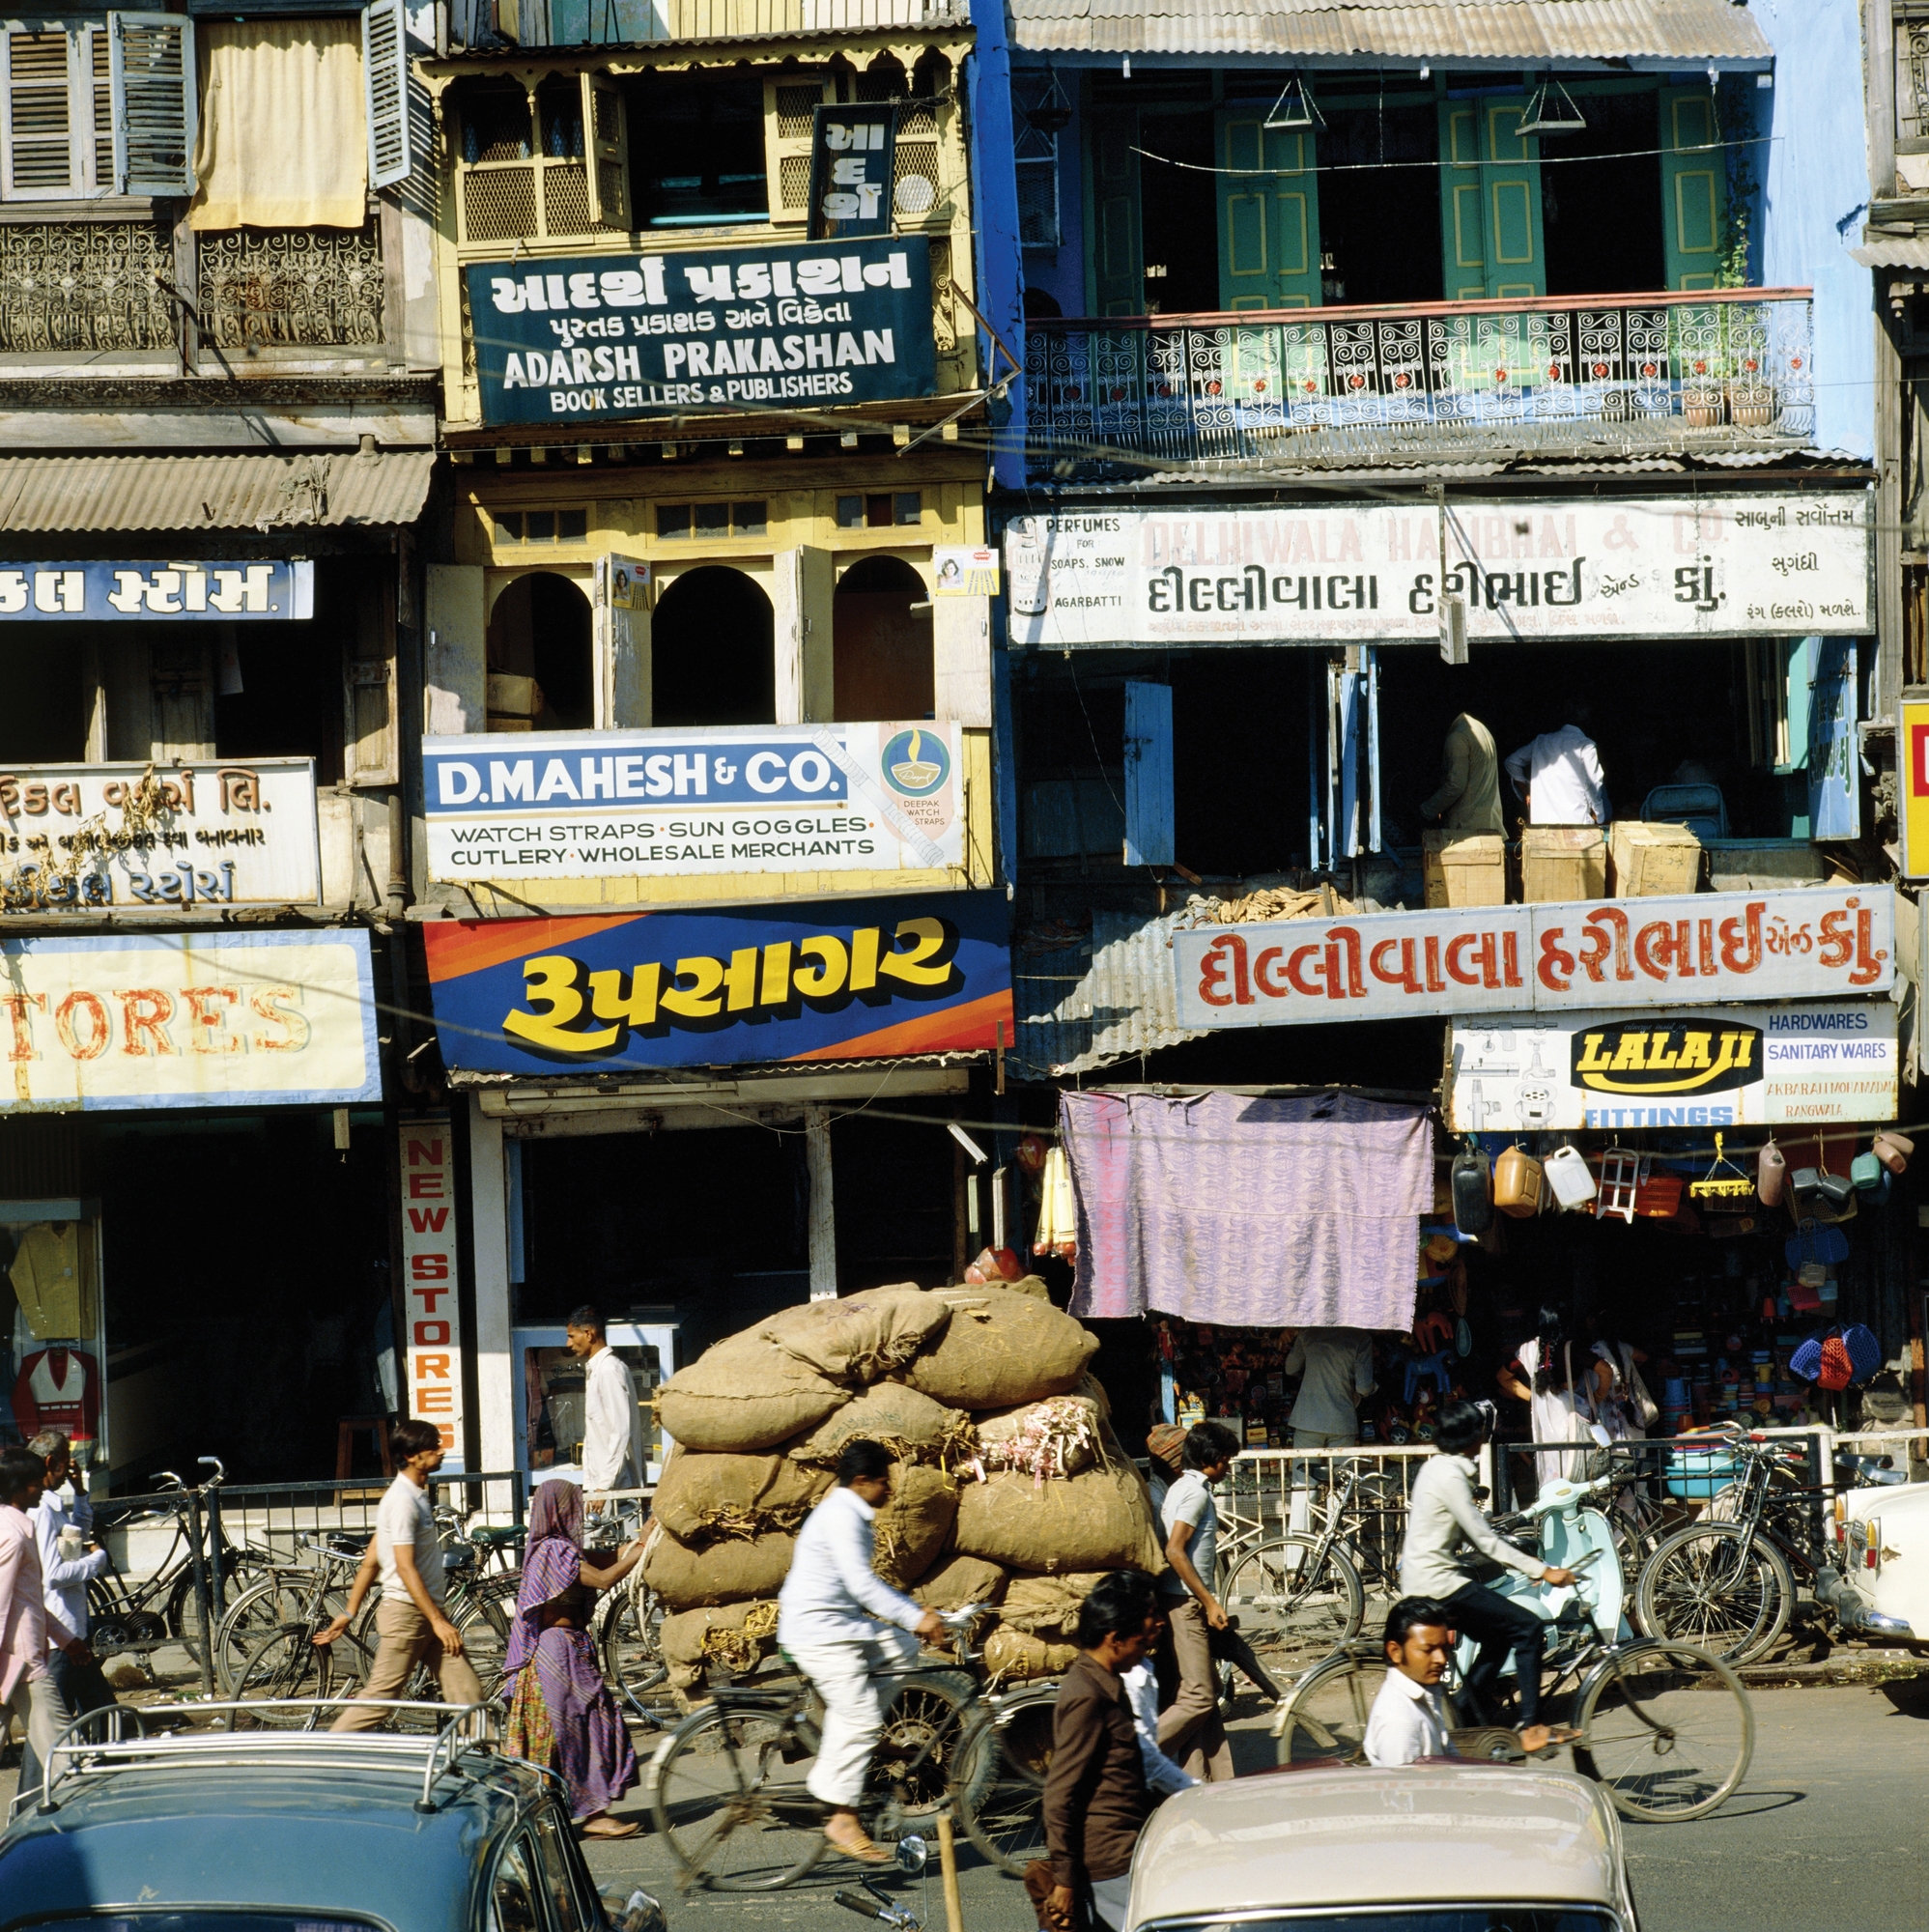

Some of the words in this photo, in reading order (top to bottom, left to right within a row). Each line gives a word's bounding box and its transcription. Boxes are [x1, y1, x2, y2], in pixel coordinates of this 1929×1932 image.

[491, 255, 667, 312] આદર્શ
[684, 252, 912, 302] પ્રકાશન
[631, 311, 717, 337] પ્રકાશક
[724, 300, 774, 331] અને
[503, 346, 641, 389] ADARSH
[663, 328, 894, 379] PRAKASHAN
[550, 388, 609, 412] BOOK
[612, 383, 705, 409] SELLERS
[709, 385, 725, 404] &
[725, 371, 854, 402] PUBLISHERS
[1045, 518, 1121, 533] PERFUMES
[1140, 518, 1364, 566] DELHIWALA
[1603, 514, 1640, 553] &
[1673, 508, 1729, 554] CO.
[1076, 538, 1095, 550] FOR
[1094, 556, 1125, 569] SNOW
[1054, 595, 1122, 610] AGARBATTI
[714, 756, 737, 785] &
[745, 751, 839, 795] CO.
[451, 825, 543, 843] WATCH
[548, 823, 655, 841] STRAPS
[668, 821, 723, 838] SUN
[731, 817, 866, 836] GOGGLES
[915, 817, 945, 826] STRAPS
[451, 848, 566, 866] CUTLERY
[579, 843, 725, 864] WHOLESALE
[731, 840, 874, 859] MERCHANTS
[1769, 1012, 1868, 1031] HARDWARES
[1768, 1044, 1838, 1061] SANITARY
[1841, 1043, 1886, 1059] WARES
[407, 1139, 449, 1233] NEW
